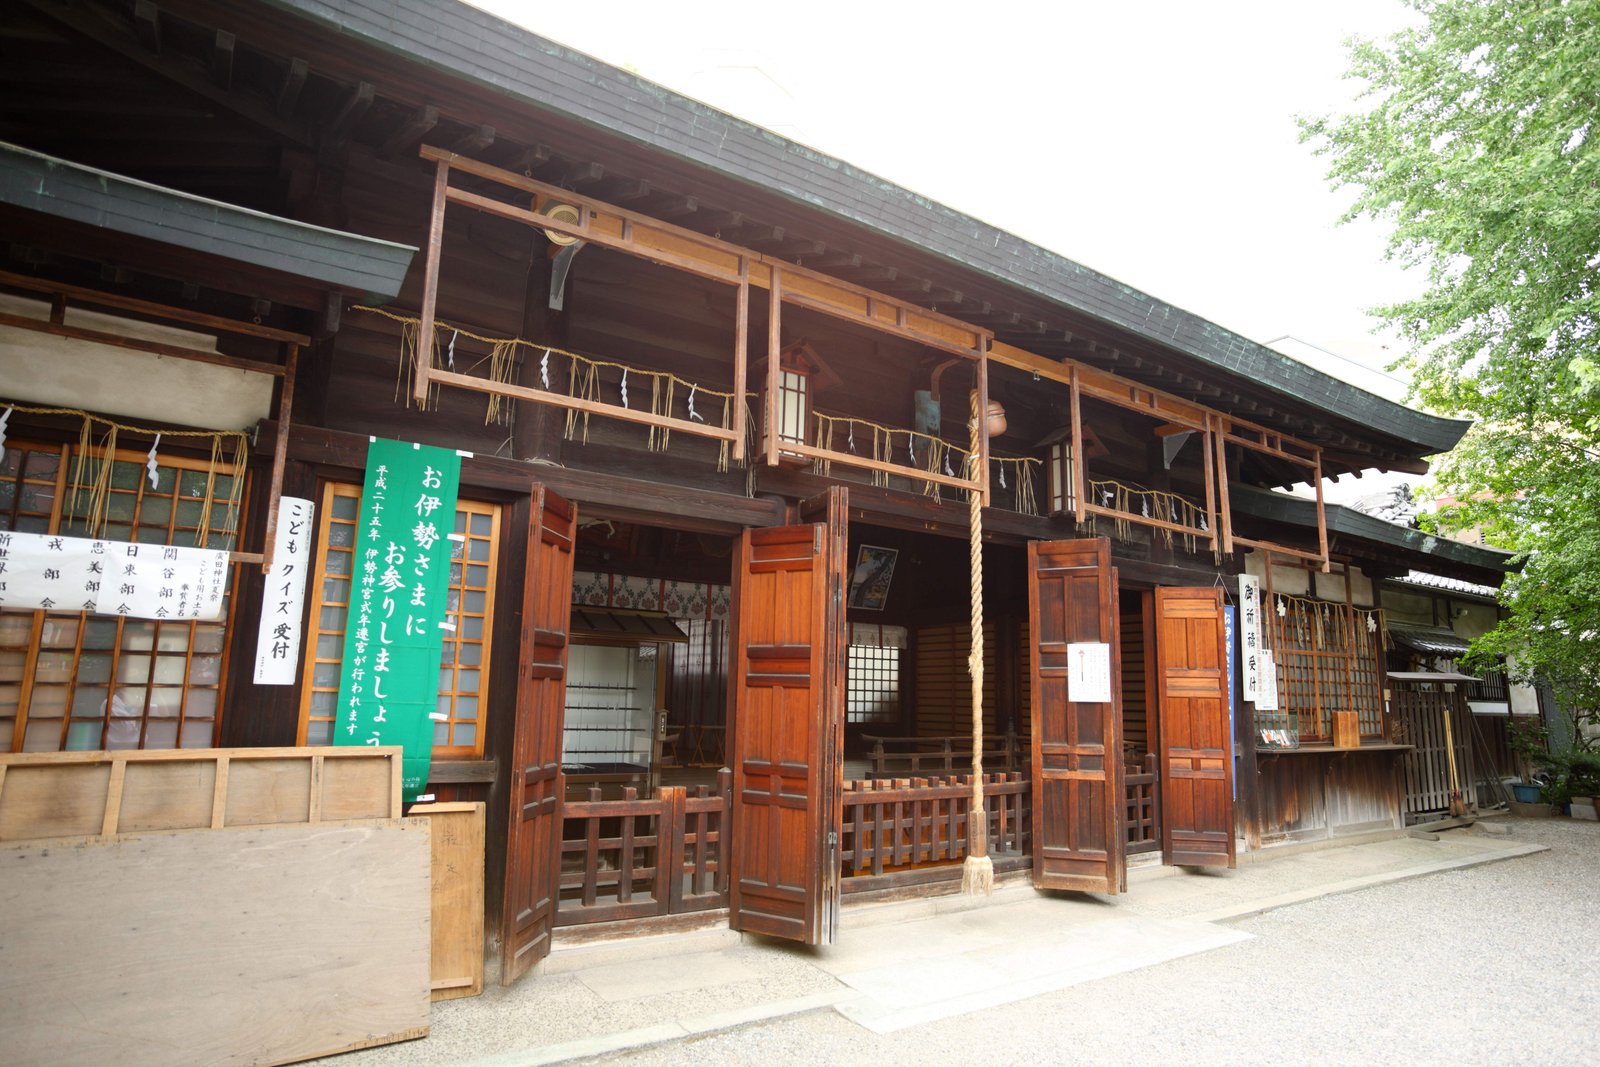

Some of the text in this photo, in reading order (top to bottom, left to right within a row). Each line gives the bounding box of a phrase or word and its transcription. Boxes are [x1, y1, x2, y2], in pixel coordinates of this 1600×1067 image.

[117, 545, 139, 615] 日東部会
[405, 465, 443, 636] お伊勢さまに
